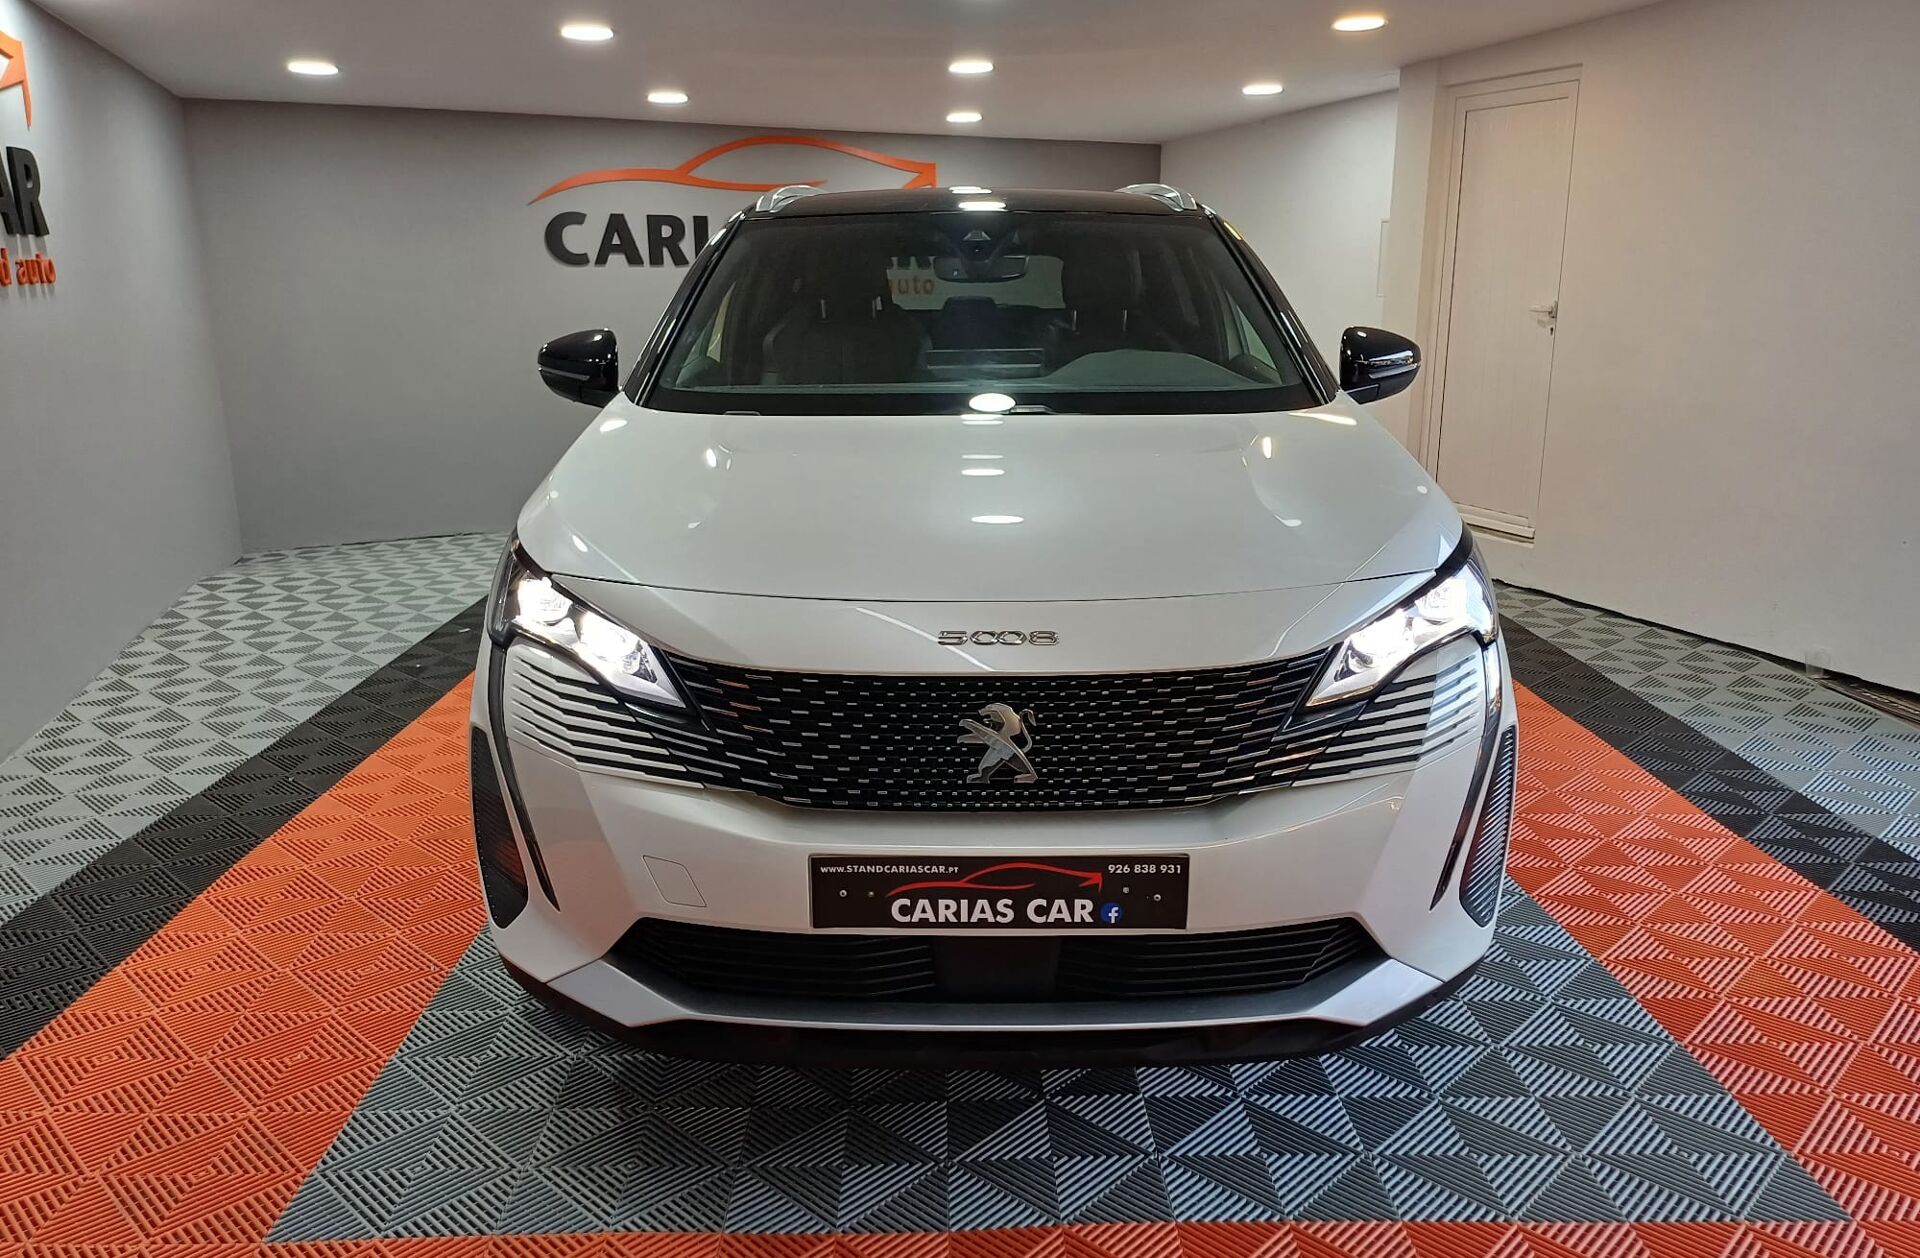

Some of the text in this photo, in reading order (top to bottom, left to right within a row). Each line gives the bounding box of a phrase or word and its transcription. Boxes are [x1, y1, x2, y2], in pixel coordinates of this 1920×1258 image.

[544, 211, 709, 267] CARI
[15, 253, 56, 285] auto
[889, 275, 935, 295] uto
[938, 630, 1060, 646] 5008
[1108, 864, 1181, 874] 926 838 931
[891, 898, 1095, 924] CARIAS CAR
